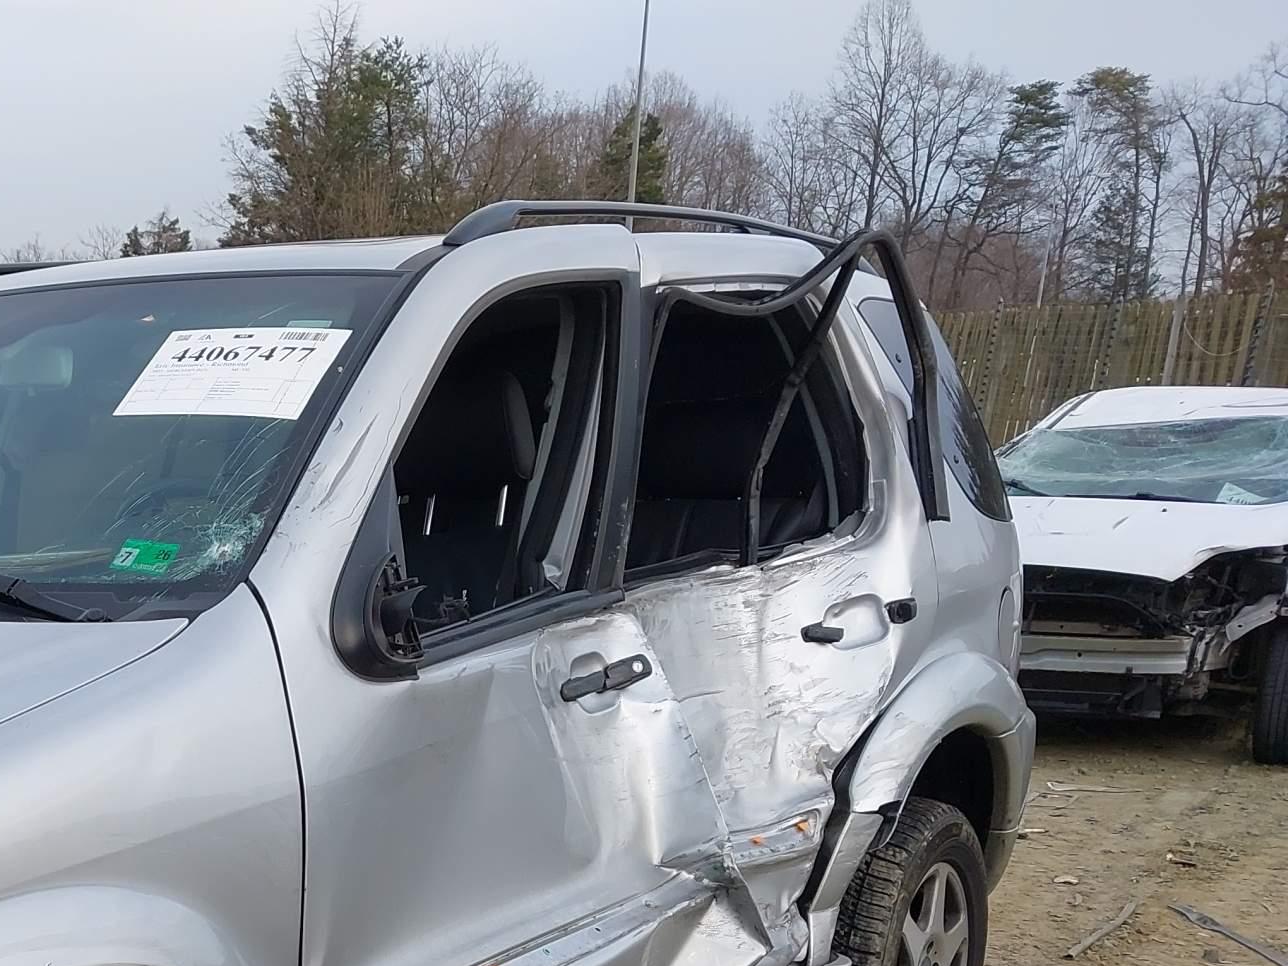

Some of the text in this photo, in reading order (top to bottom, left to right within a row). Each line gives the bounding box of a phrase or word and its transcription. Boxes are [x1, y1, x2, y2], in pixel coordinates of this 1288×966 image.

[171, 345, 318, 362] 44067477
[120, 550, 171, 563] 7 26
